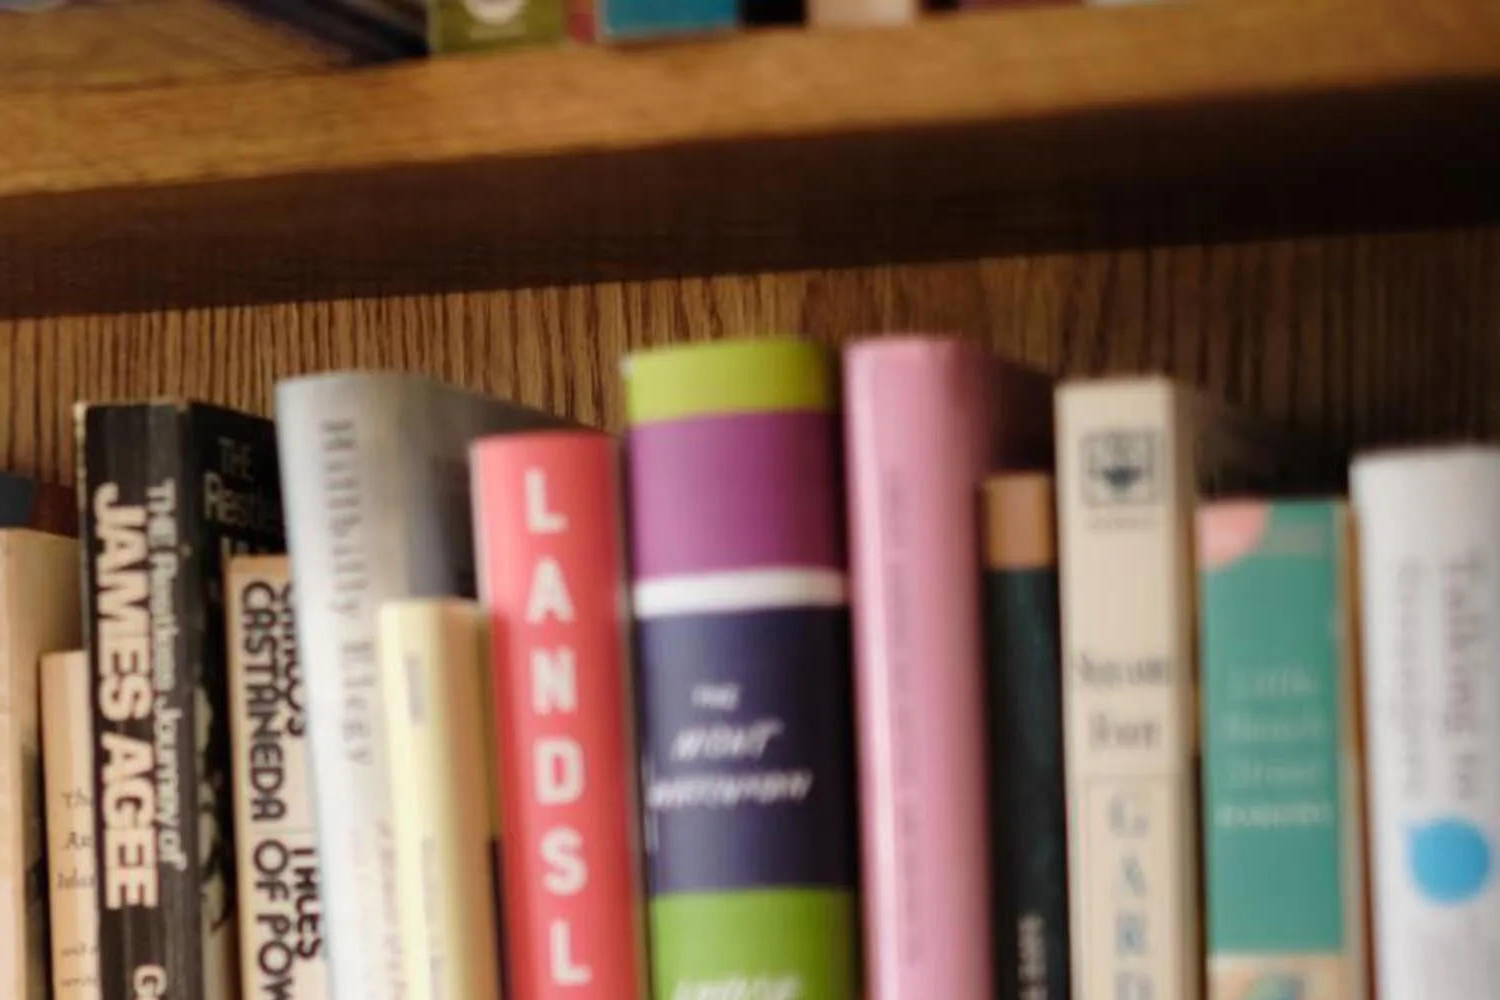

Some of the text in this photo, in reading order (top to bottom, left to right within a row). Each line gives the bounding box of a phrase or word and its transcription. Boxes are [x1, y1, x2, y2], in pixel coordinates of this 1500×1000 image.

[146, 480, 176, 548] THE
[93, 482, 158, 910] JAMES AGEE
[242, 579, 289, 825] CASTANEDA
[153, 698, 186, 824] Journey
[159, 830, 188, 872] of
[253, 840, 291, 902] OF
